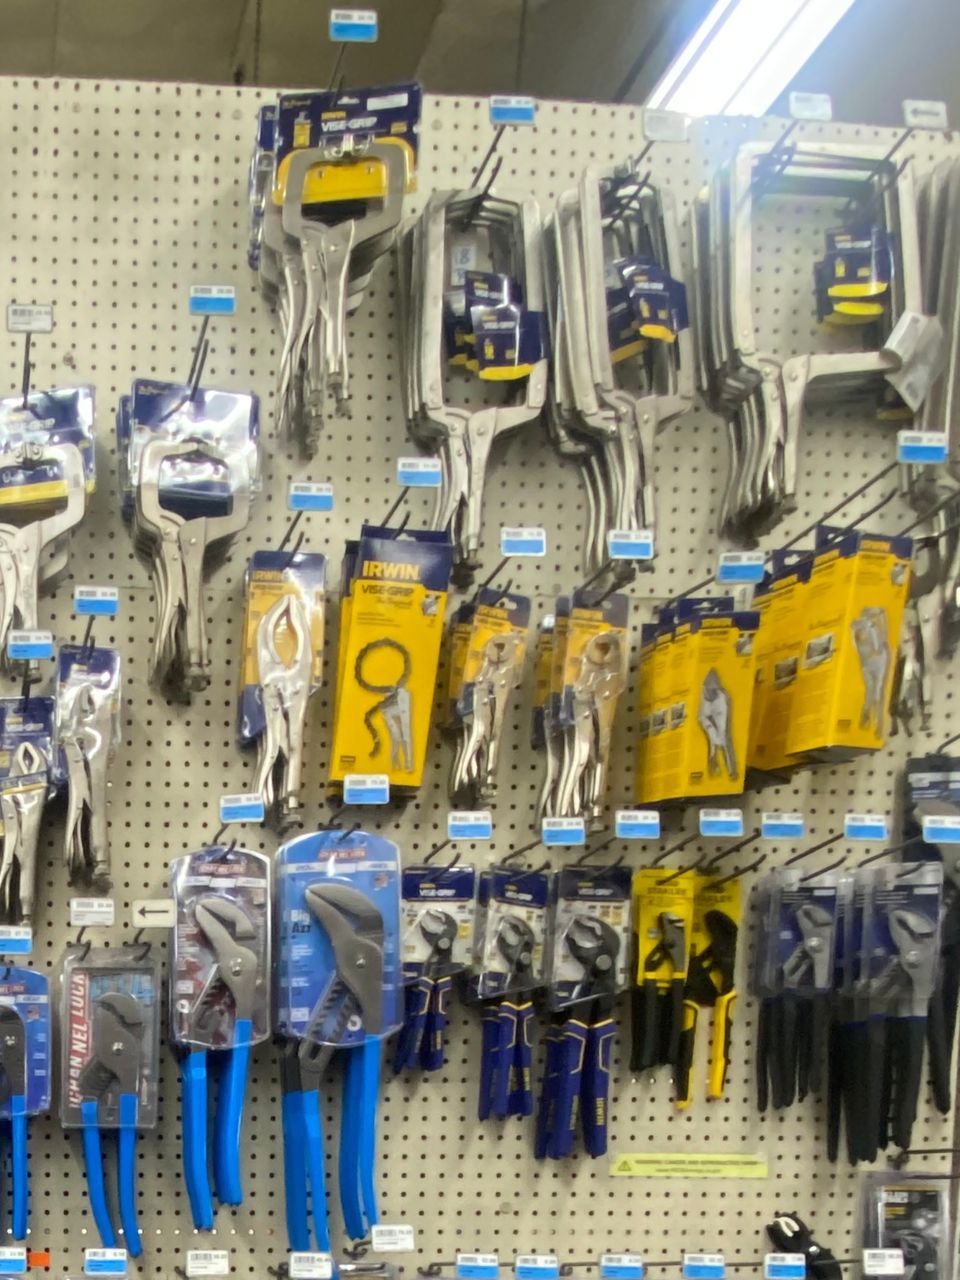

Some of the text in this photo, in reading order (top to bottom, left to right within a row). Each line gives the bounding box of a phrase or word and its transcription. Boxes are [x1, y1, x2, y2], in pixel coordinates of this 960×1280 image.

[321, 117, 377, 132] VISE-GRIP
[363, 560, 419, 580] IRWIN
[362, 584, 414, 597] VISE-GRIP
[291, 910, 310, 924] Big
